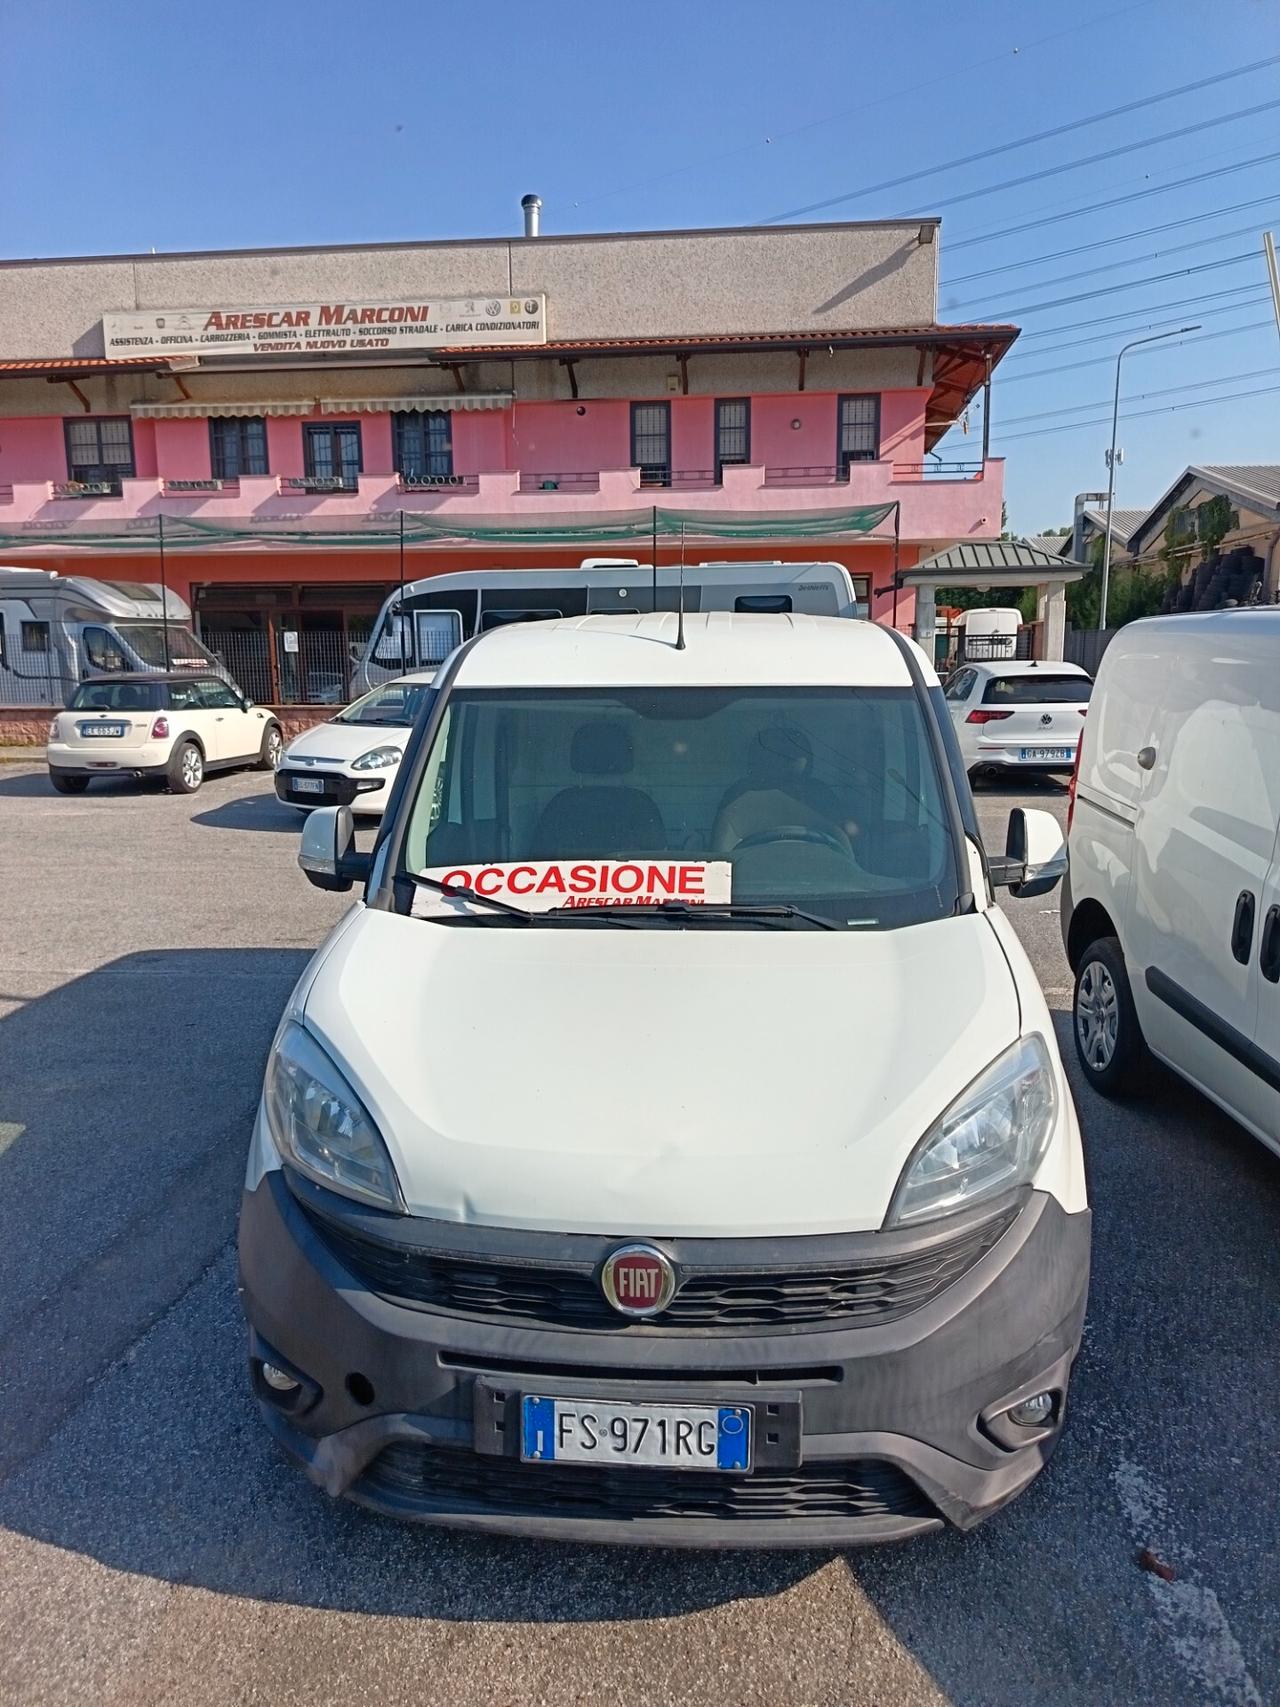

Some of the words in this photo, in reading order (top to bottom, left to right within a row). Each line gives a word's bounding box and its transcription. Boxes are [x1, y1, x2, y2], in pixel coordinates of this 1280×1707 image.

[203, 310, 311, 331] ARESCAR
[318, 304, 429, 326] MARCONI
[109, 336, 154, 346] ASSISTENZA
[161, 335, 193, 344] OFFICINA
[200, 332, 250, 343] CARROZZERIA
[258, 331, 297, 340] GOMMISTA
[305, 328, 351, 338] ELETTRAUTO
[358, 326, 397, 336] SOCCORSO
[399, 324, 439, 334] STRADALE
[445, 322, 473, 332] CARICA
[475, 320, 540, 331] CONDIZIONATORI
[253, 341, 302, 352] VENDITA
[306, 339, 346, 350] NUOVO
[350, 338, 389, 348] USATO
[441, 865, 705, 897] OCCASIONE
[618, 1267, 659, 1298] FIAT
